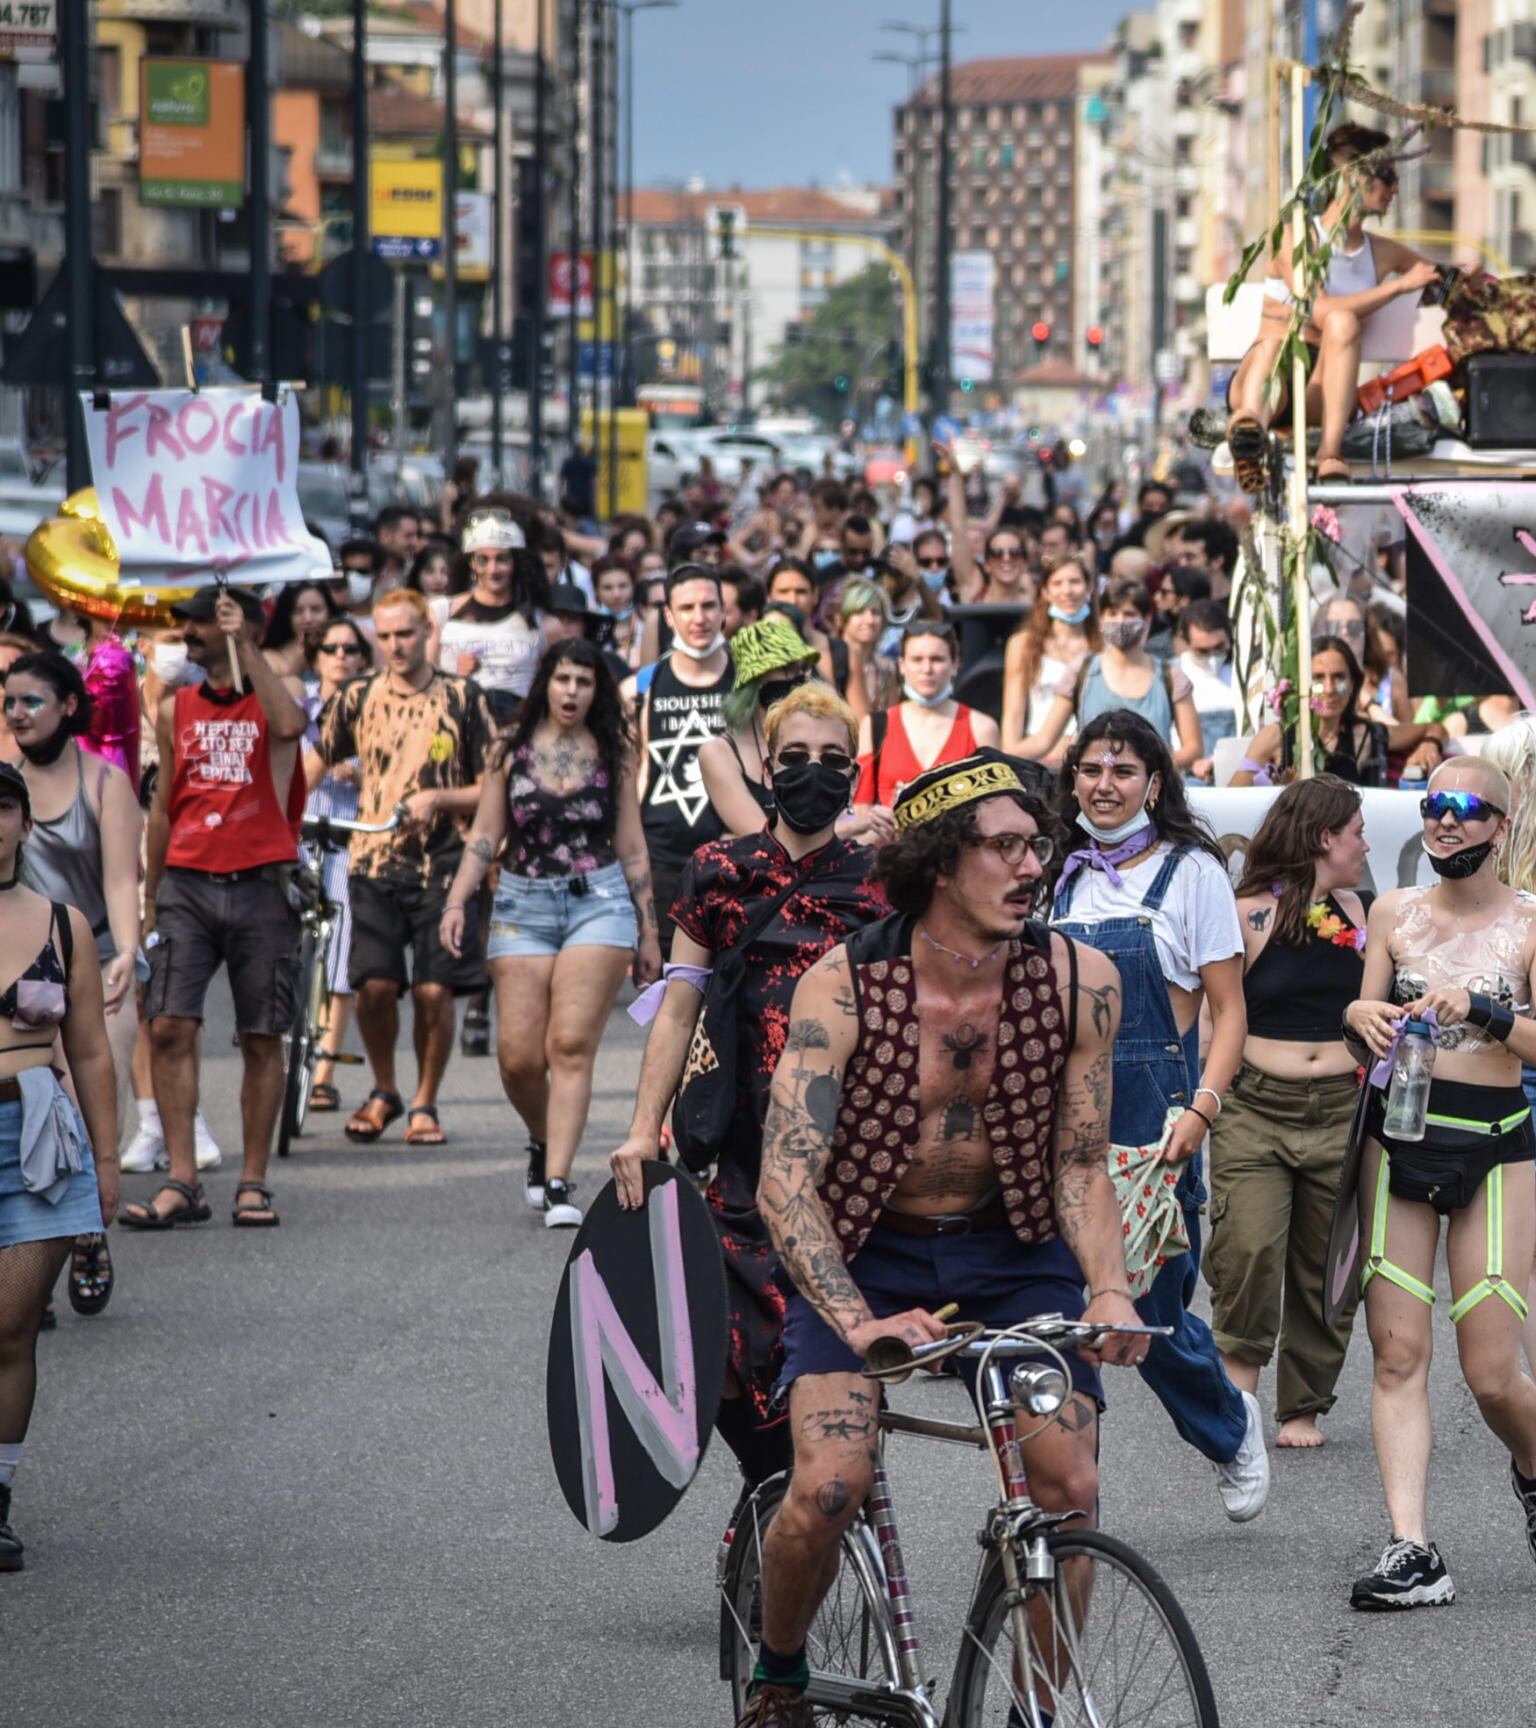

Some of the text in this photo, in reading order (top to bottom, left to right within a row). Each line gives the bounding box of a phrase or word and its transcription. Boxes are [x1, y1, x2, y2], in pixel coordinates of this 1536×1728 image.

[105, 393, 286, 484] FROCIA
[112, 472, 296, 555] MARCIA
[654, 693, 723, 712] SIOUXSIE
[569, 1177, 699, 1537] N
